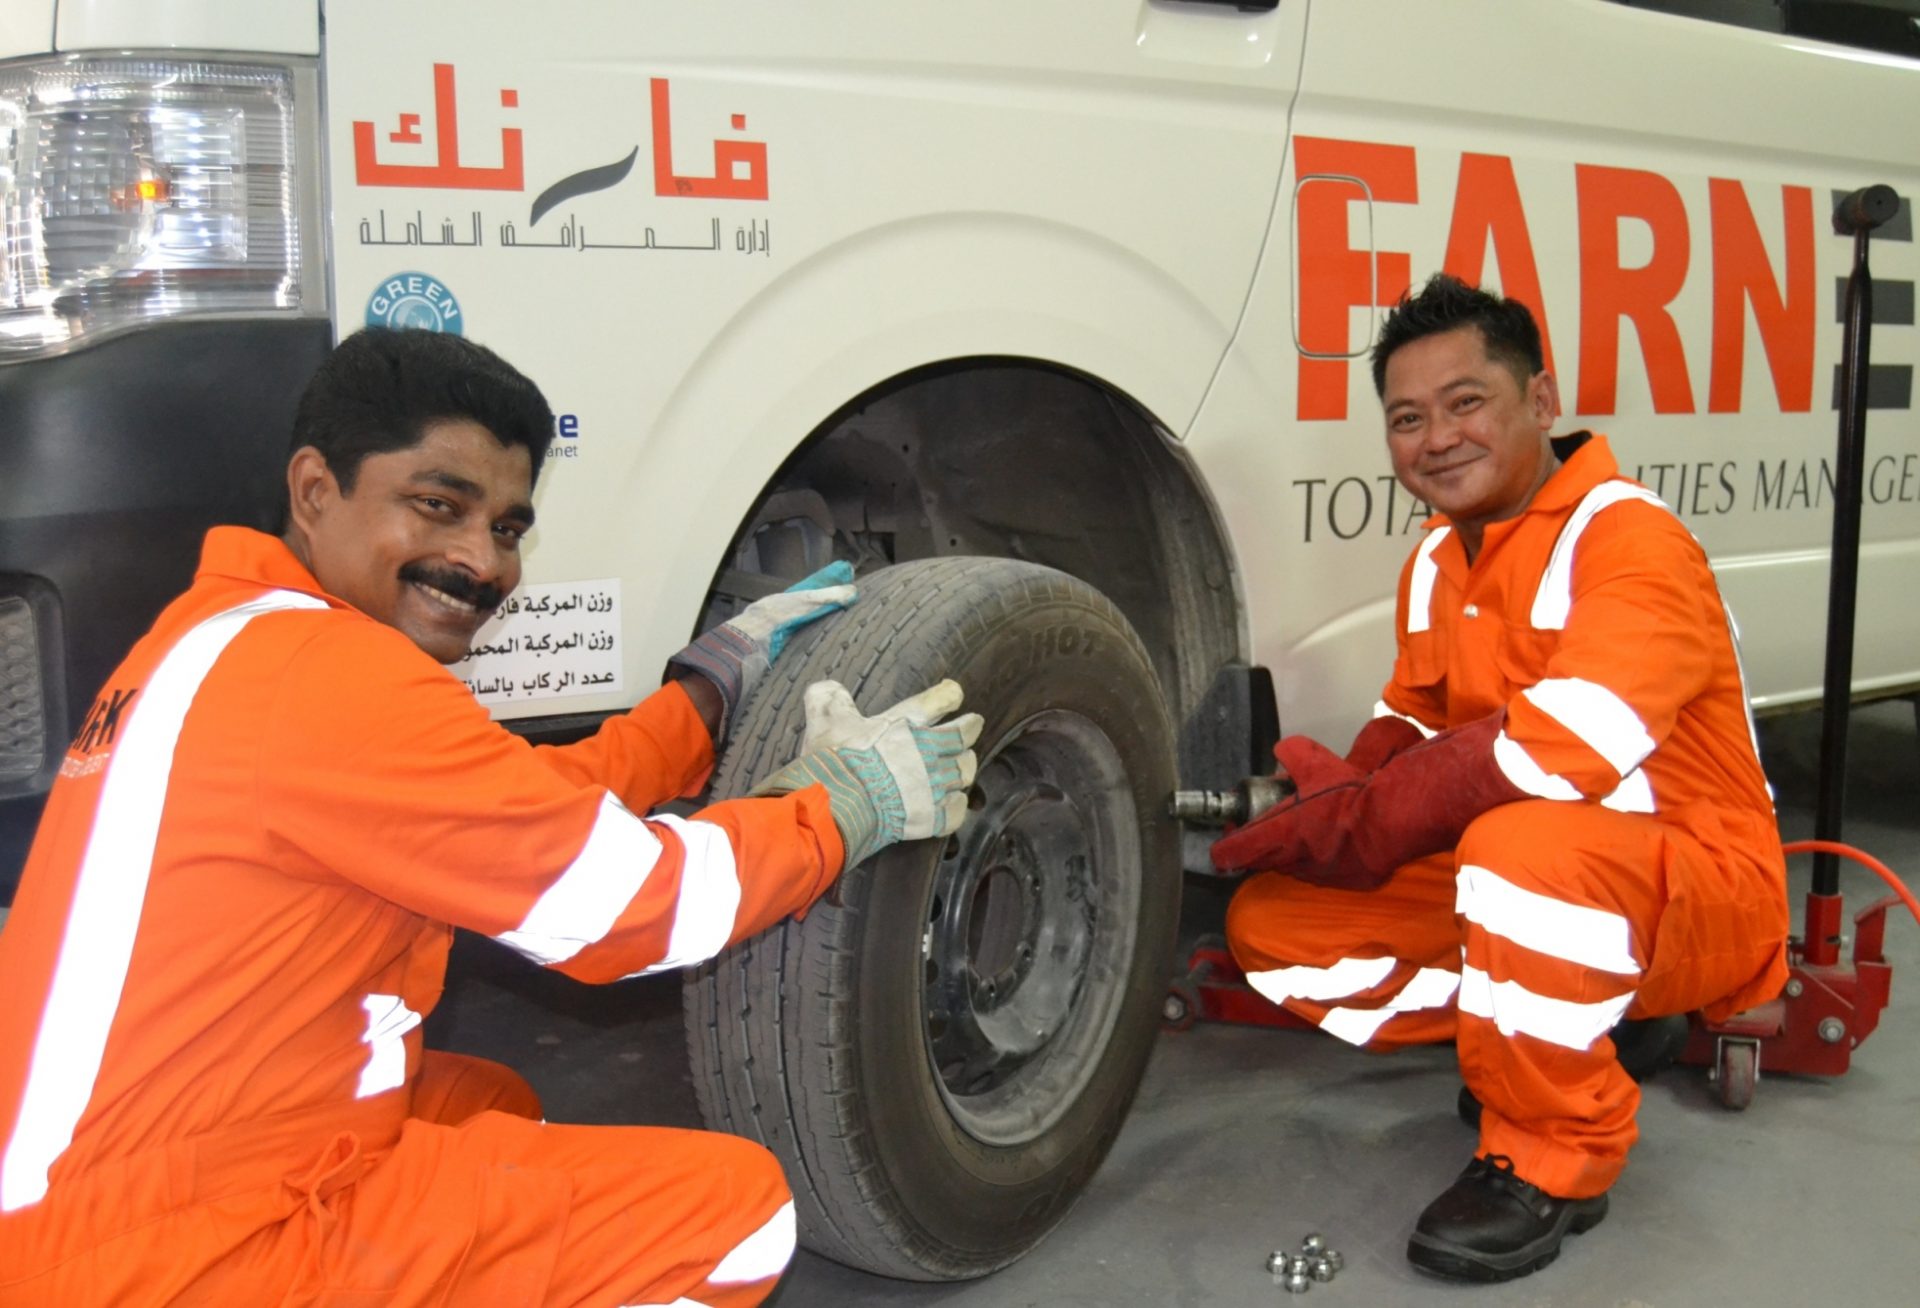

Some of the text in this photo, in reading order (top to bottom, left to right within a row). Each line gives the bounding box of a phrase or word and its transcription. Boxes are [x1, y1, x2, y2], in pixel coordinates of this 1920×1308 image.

[360, 209, 482, 246] الشاملة
[736, 218, 770, 258] إدارة
[371, 277, 458, 320] GREEN
[546, 445, 579, 458] anet
[1292, 475, 1433, 544] TOTA
[1753, 453, 1920, 512] MANGE
[496, 591, 613, 620] وزن المركبة فار
[524, 632, 584, 658] المركبة
[588, 629, 614, 651] وزن
[521, 671, 575, 696] الركاب
[581, 671, 615, 685] عدد
